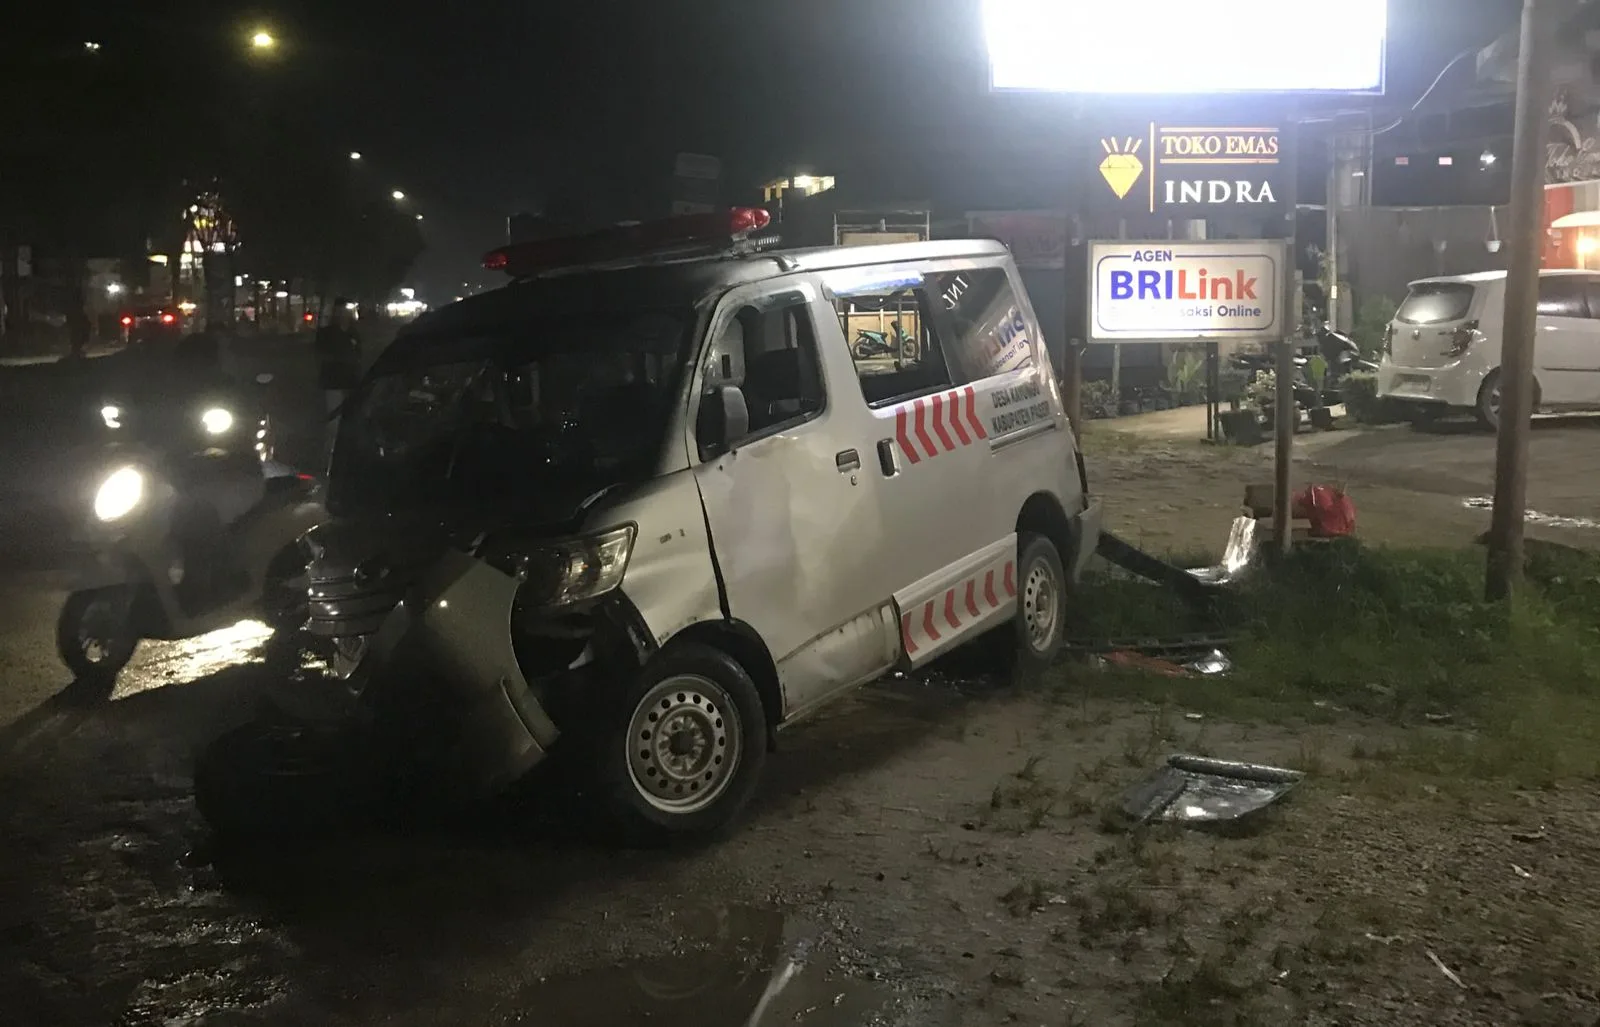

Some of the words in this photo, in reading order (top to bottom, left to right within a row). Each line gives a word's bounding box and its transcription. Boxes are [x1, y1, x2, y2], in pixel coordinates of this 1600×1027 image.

[1161, 135, 1222, 155] TOKO
[1224, 135, 1279, 154] EMAS
[1164, 180, 1277, 203] INDRA
[1132, 250, 1173, 263] AGEN
[1110, 267, 1258, 300] BRILink
[1217, 304, 1262, 318] Online
